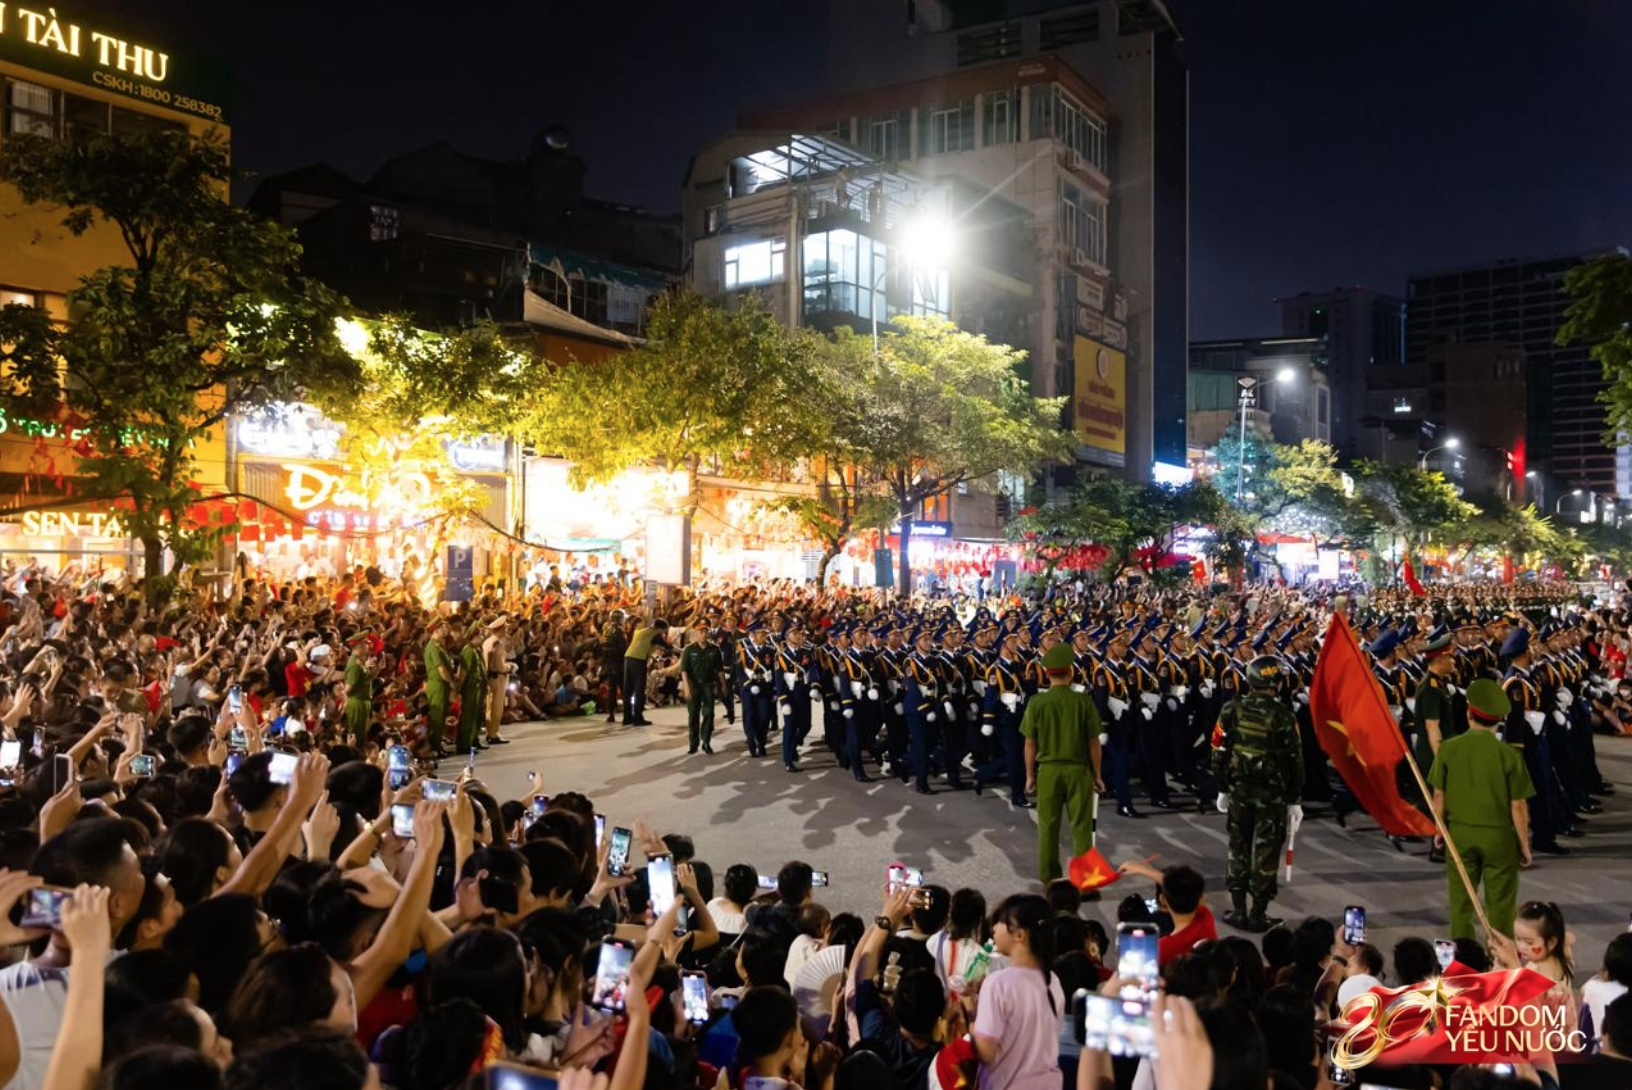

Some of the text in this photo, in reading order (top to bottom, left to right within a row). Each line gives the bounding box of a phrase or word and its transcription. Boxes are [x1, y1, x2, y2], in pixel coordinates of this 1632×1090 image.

[18, 7, 80, 57] TÀI
[91, 31, 169, 81] THU
[22, 510, 80, 537] SEN
